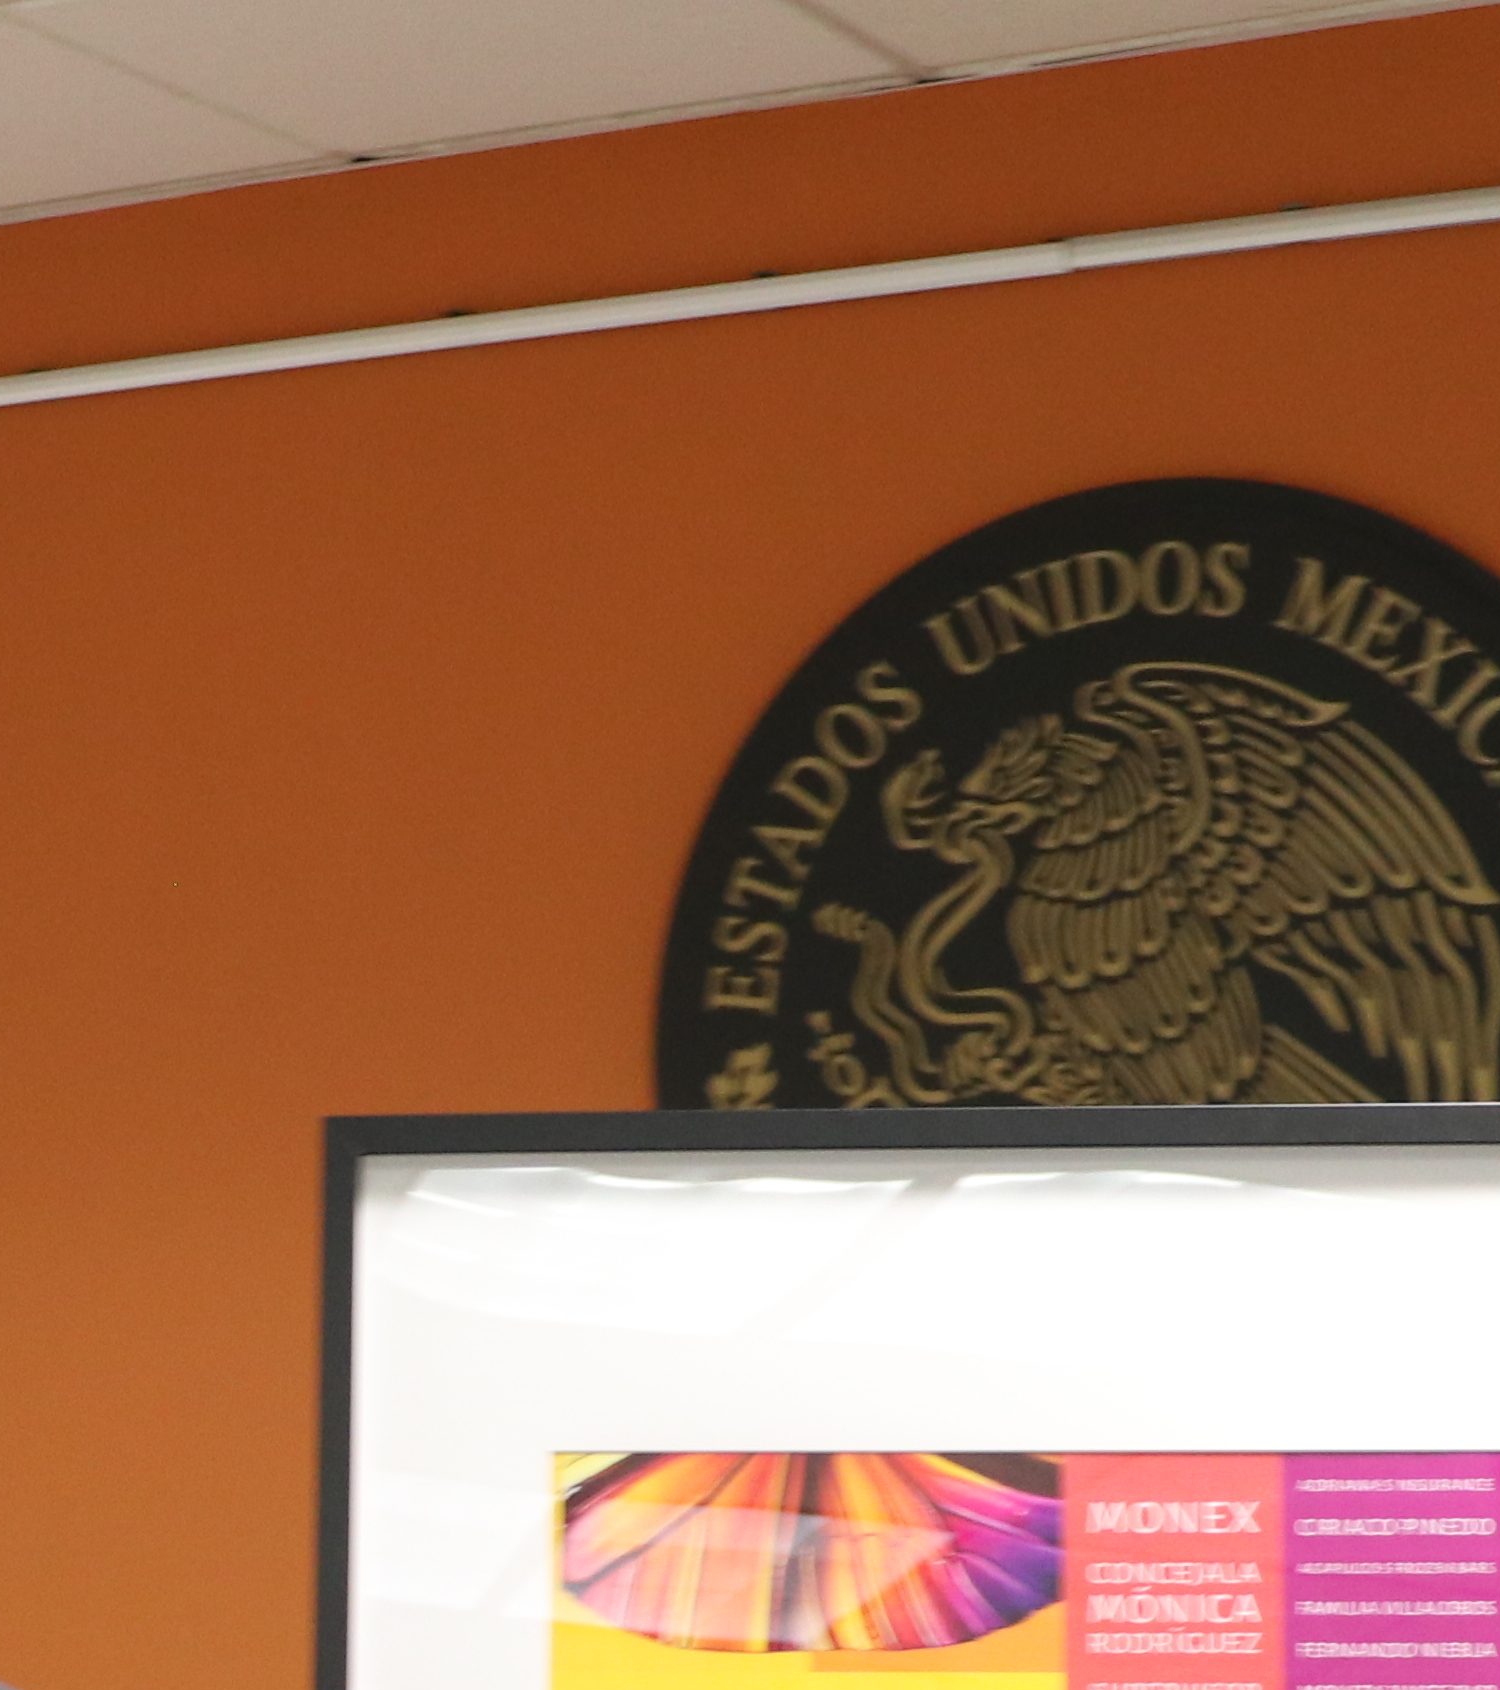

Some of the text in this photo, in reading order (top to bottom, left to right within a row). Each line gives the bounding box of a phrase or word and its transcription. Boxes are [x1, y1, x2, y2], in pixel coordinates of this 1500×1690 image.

[707, 662, 923, 1016] ESTADOS
[923, 541, 1251, 676] UNIDOS
[1085, 1500, 1262, 1534] MONEX
[1086, 1585, 1263, 1623] MÓNICA
